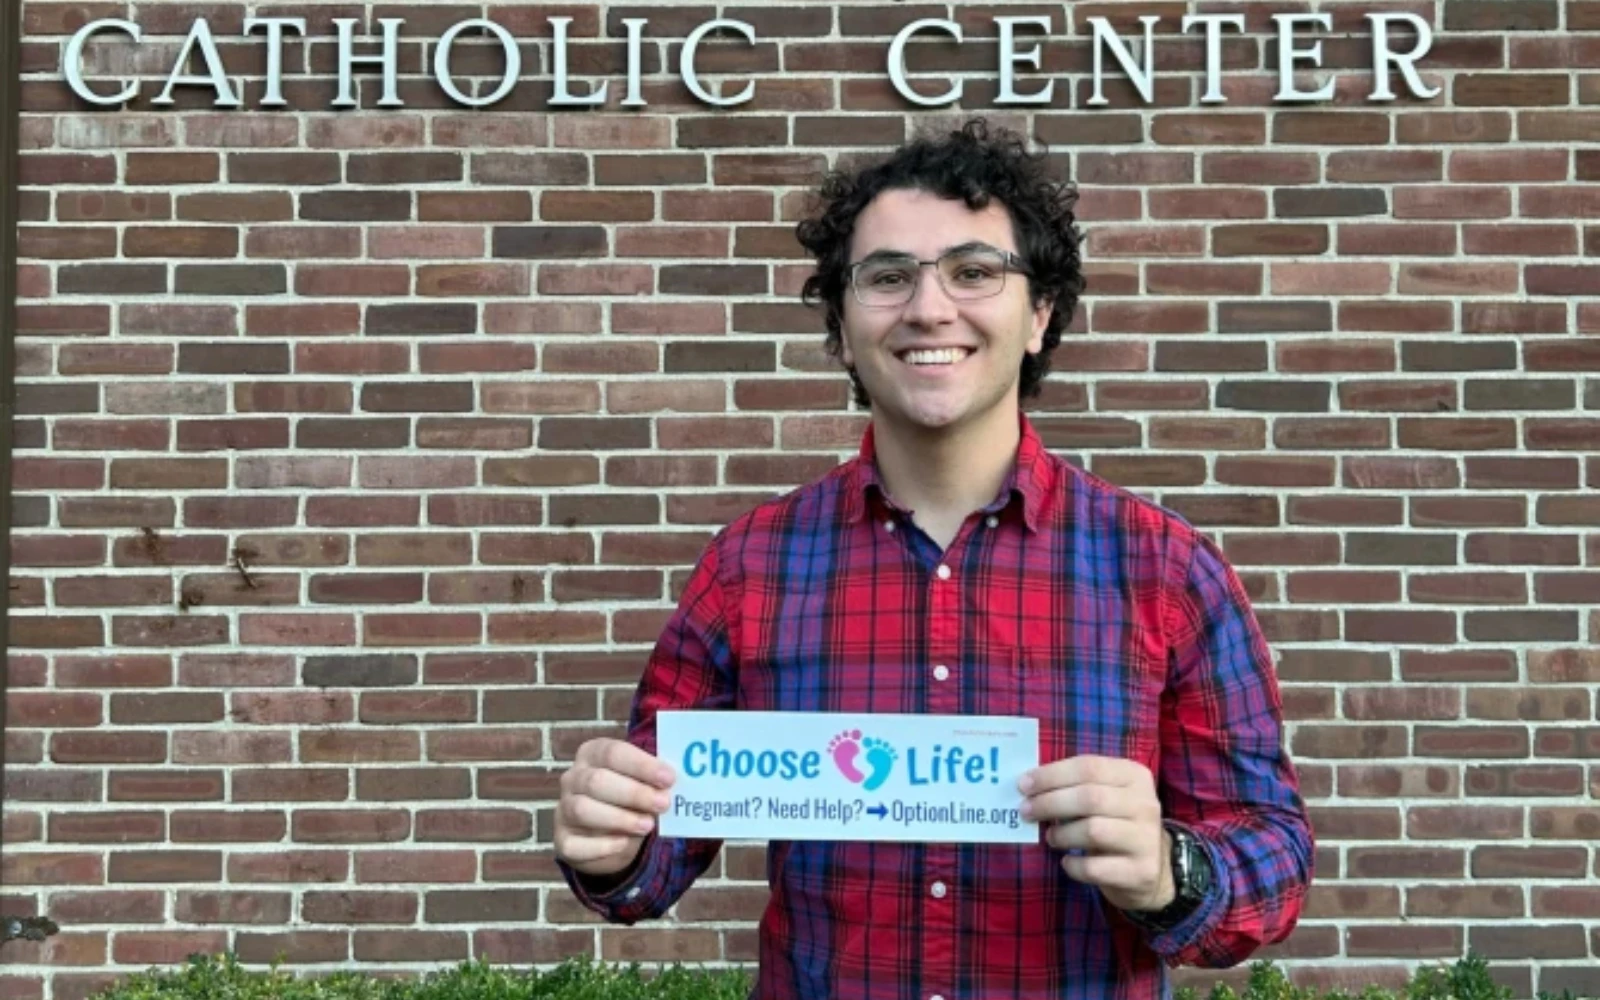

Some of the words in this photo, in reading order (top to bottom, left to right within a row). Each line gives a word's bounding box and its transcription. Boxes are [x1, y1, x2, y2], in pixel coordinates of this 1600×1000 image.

[62, 17, 757, 107] CATHOLIC
[886, 12, 1442, 106] CENTER
[683, 739, 821, 780] Choose
[907, 744, 1000, 786] Life!
[674, 795, 762, 819] Pregnant?
[767, 798, 810, 820] Need
[814, 799, 864, 825] Help?
[891, 801, 1020, 828] OptionLine.org
